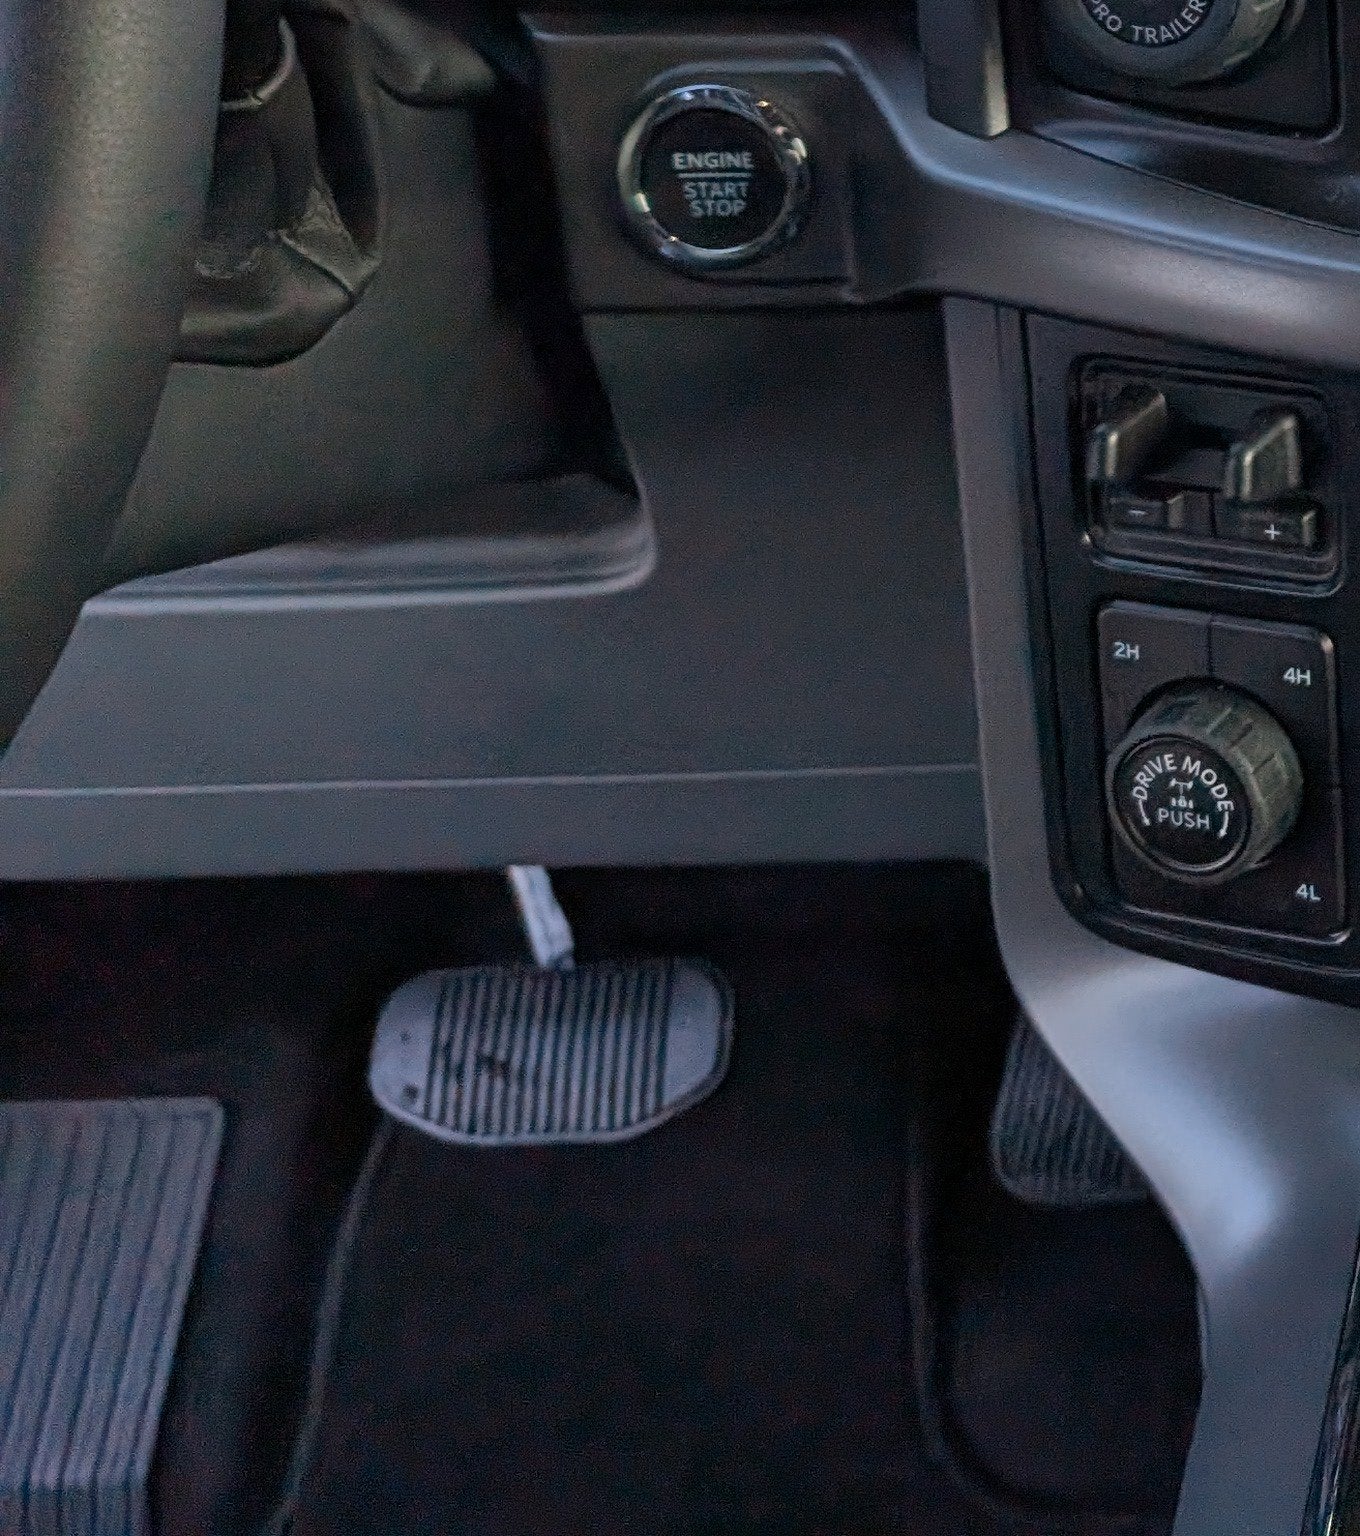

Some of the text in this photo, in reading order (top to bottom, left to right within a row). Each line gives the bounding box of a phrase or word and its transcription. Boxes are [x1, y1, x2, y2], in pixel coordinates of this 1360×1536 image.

[672, 152, 754, 169] ENGINE
[683, 181, 749, 199] START
[689, 199, 747, 218] STOP
[1114, 642, 1140, 661] 2H
[1283, 667, 1311, 686] 4H
[1133, 754, 1234, 811] DRIVE MODE
[1158, 808, 1209, 831] PUSH
[1296, 884, 1320, 902] 4L
